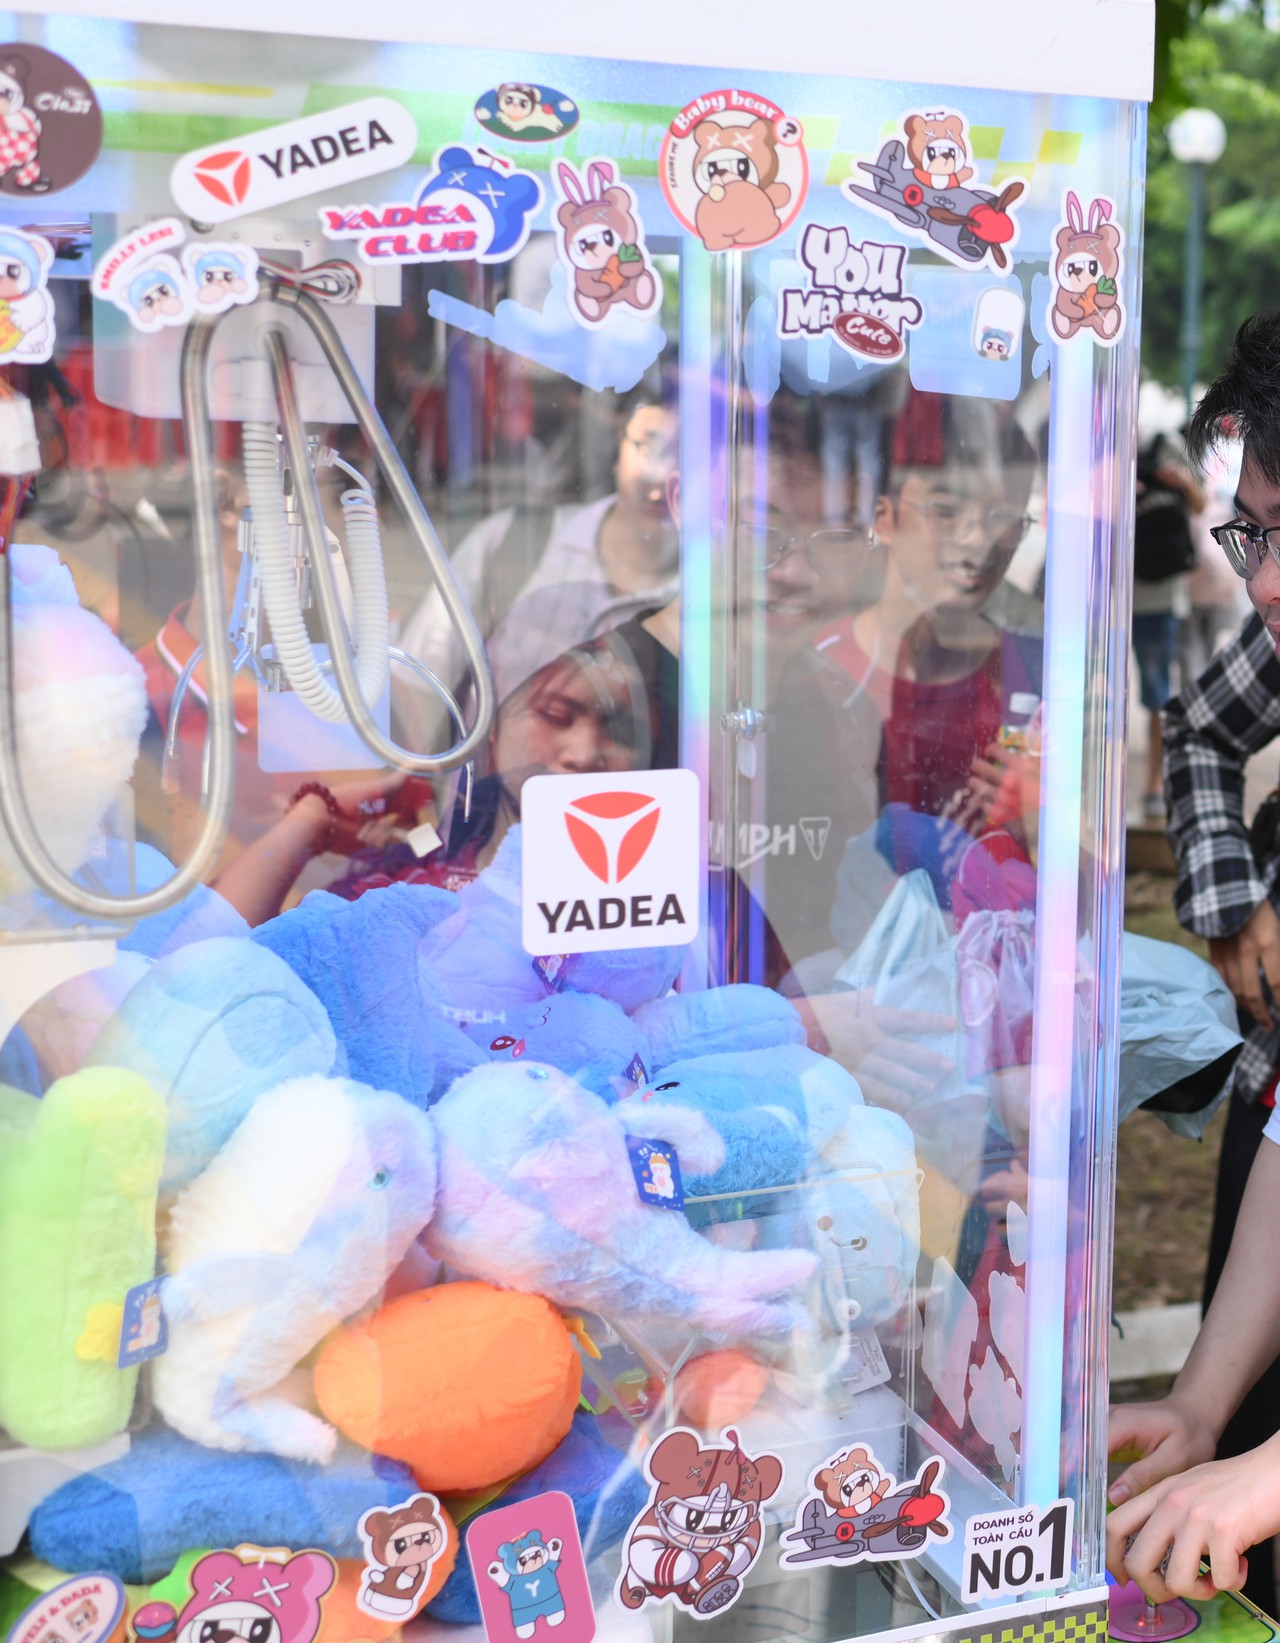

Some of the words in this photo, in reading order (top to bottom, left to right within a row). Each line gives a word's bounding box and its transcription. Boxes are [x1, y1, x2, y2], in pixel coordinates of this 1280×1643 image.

[672, 94, 727, 131] Baby
[731, 89, 779, 119] bear
[257, 119, 394, 180] YADEA
[325, 203, 477, 231] YADEA
[364, 230, 478, 257] CLUB
[845, 316, 892, 345] Cute
[537, 893, 686, 933] YADEA
[973, 1516, 1015, 1532] DOANH
[1018, 1510, 1034, 1525] SỐ
[973, 1532, 1004, 1546] TOÀN
